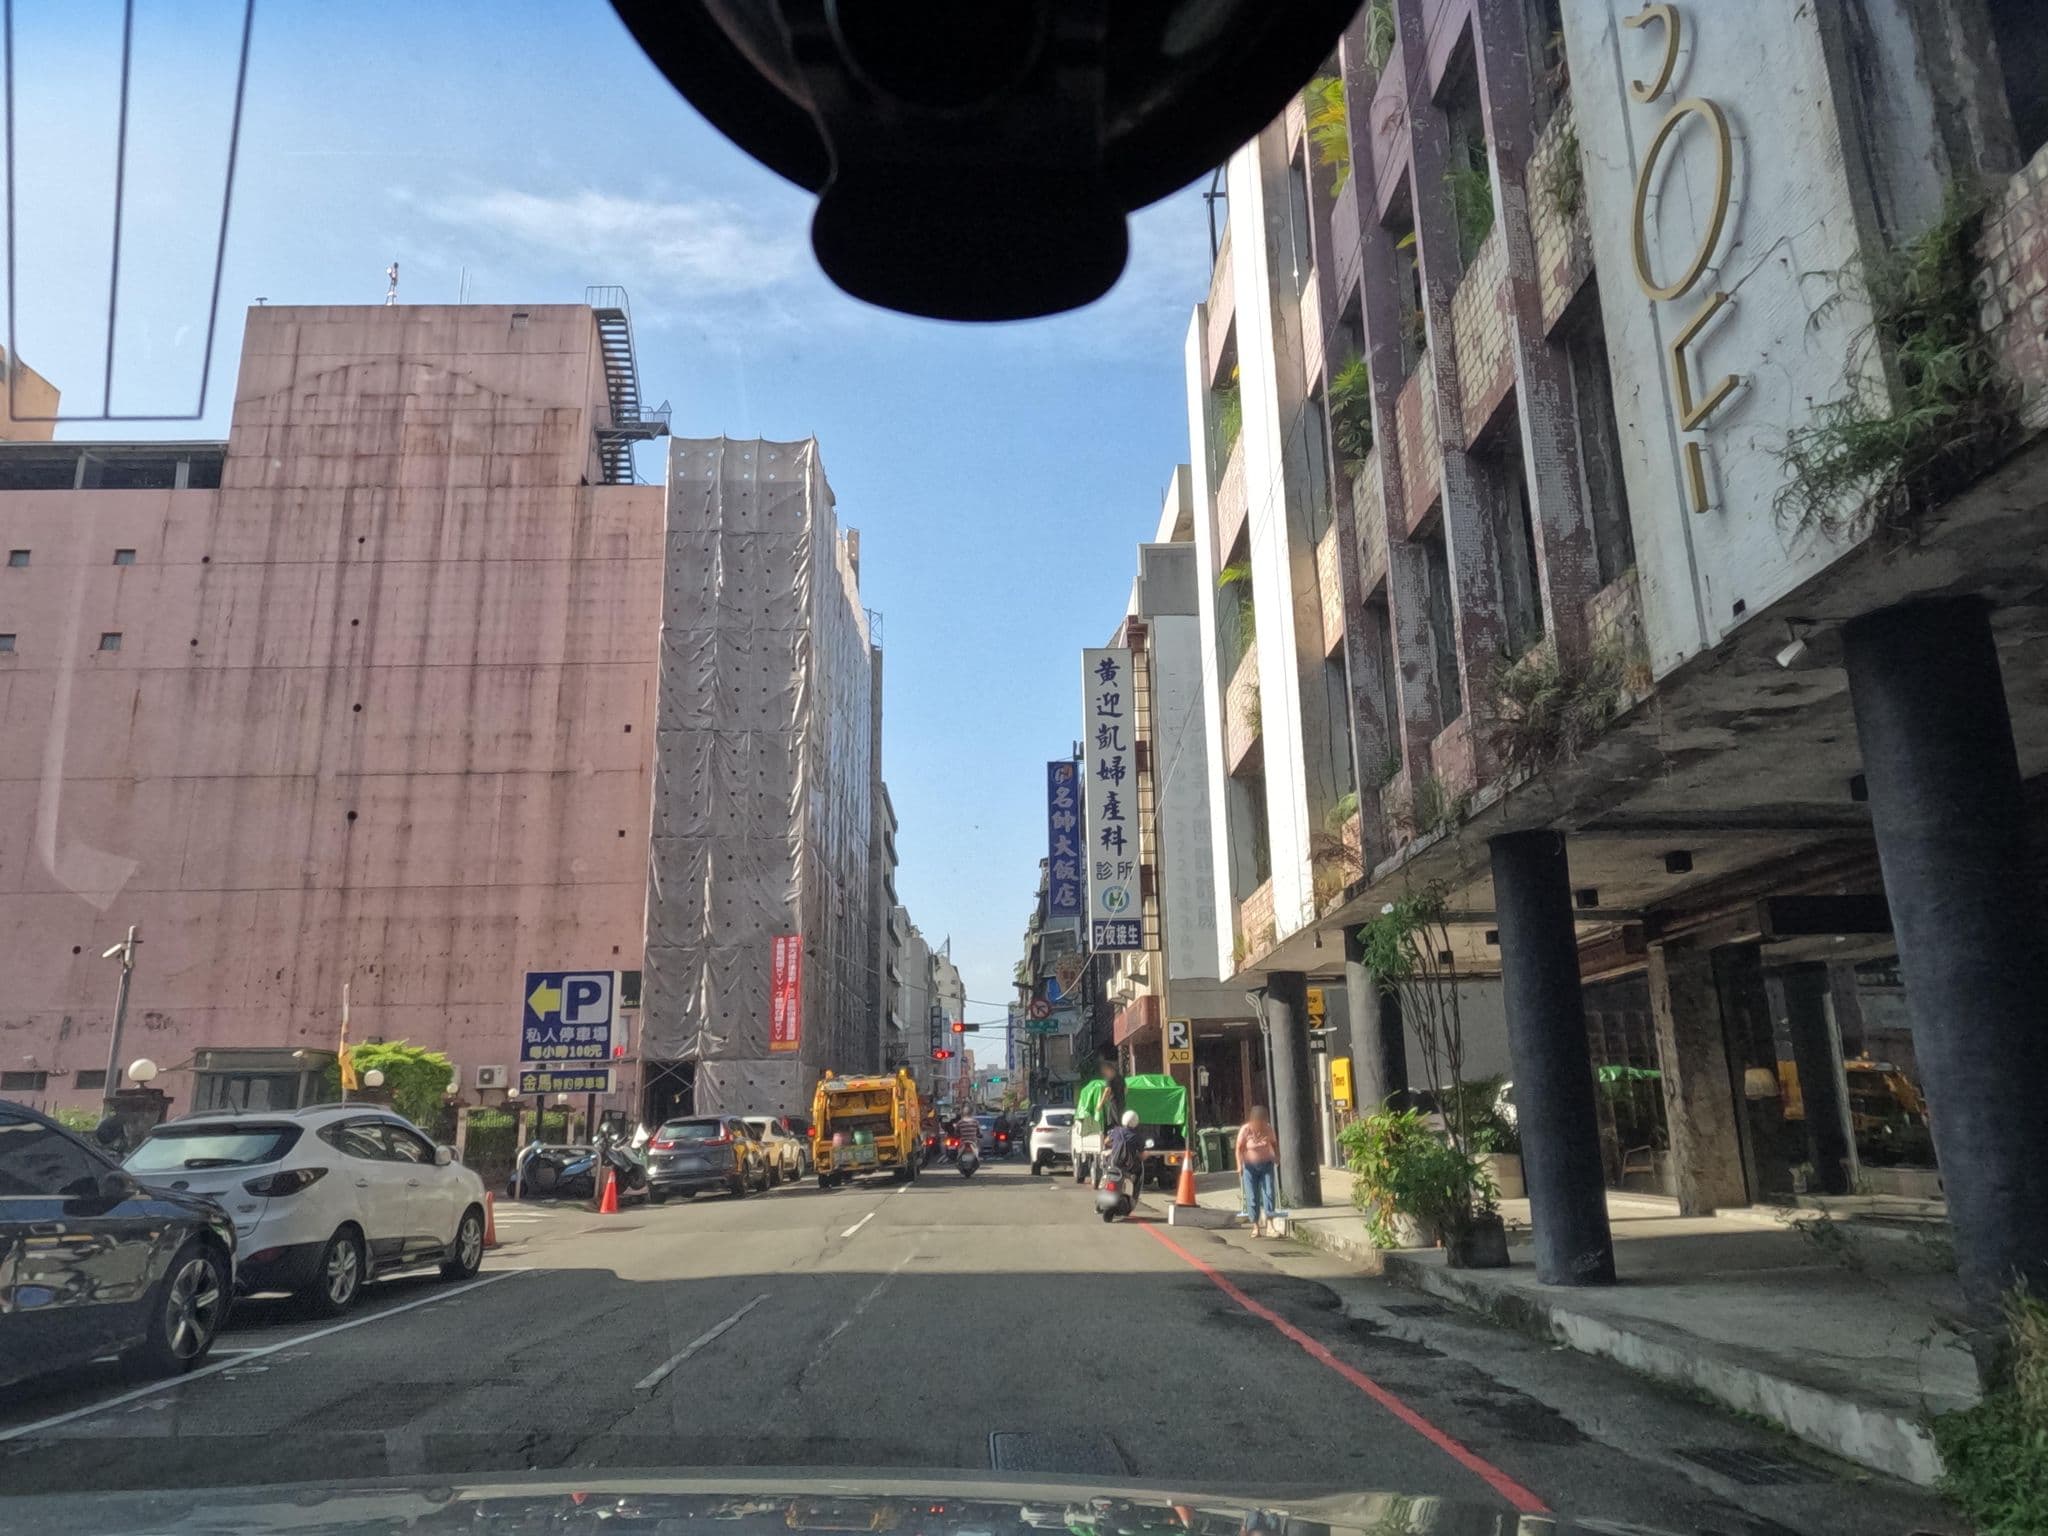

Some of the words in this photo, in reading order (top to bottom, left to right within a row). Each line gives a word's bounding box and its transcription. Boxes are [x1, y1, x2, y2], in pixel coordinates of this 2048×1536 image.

[1094, 657, 1128, 856] 黃迎凱婦產科
[1052, 786, 1079, 907] 名帥大飯店
[1096, 861, 1133, 880] 診所
[1095, 924, 1139, 945] 日夜接生
[566, 981, 602, 1020] P
[526, 1026, 608, 1043] 私人停車場
[1170, 1051, 1189, 1060] 入口
